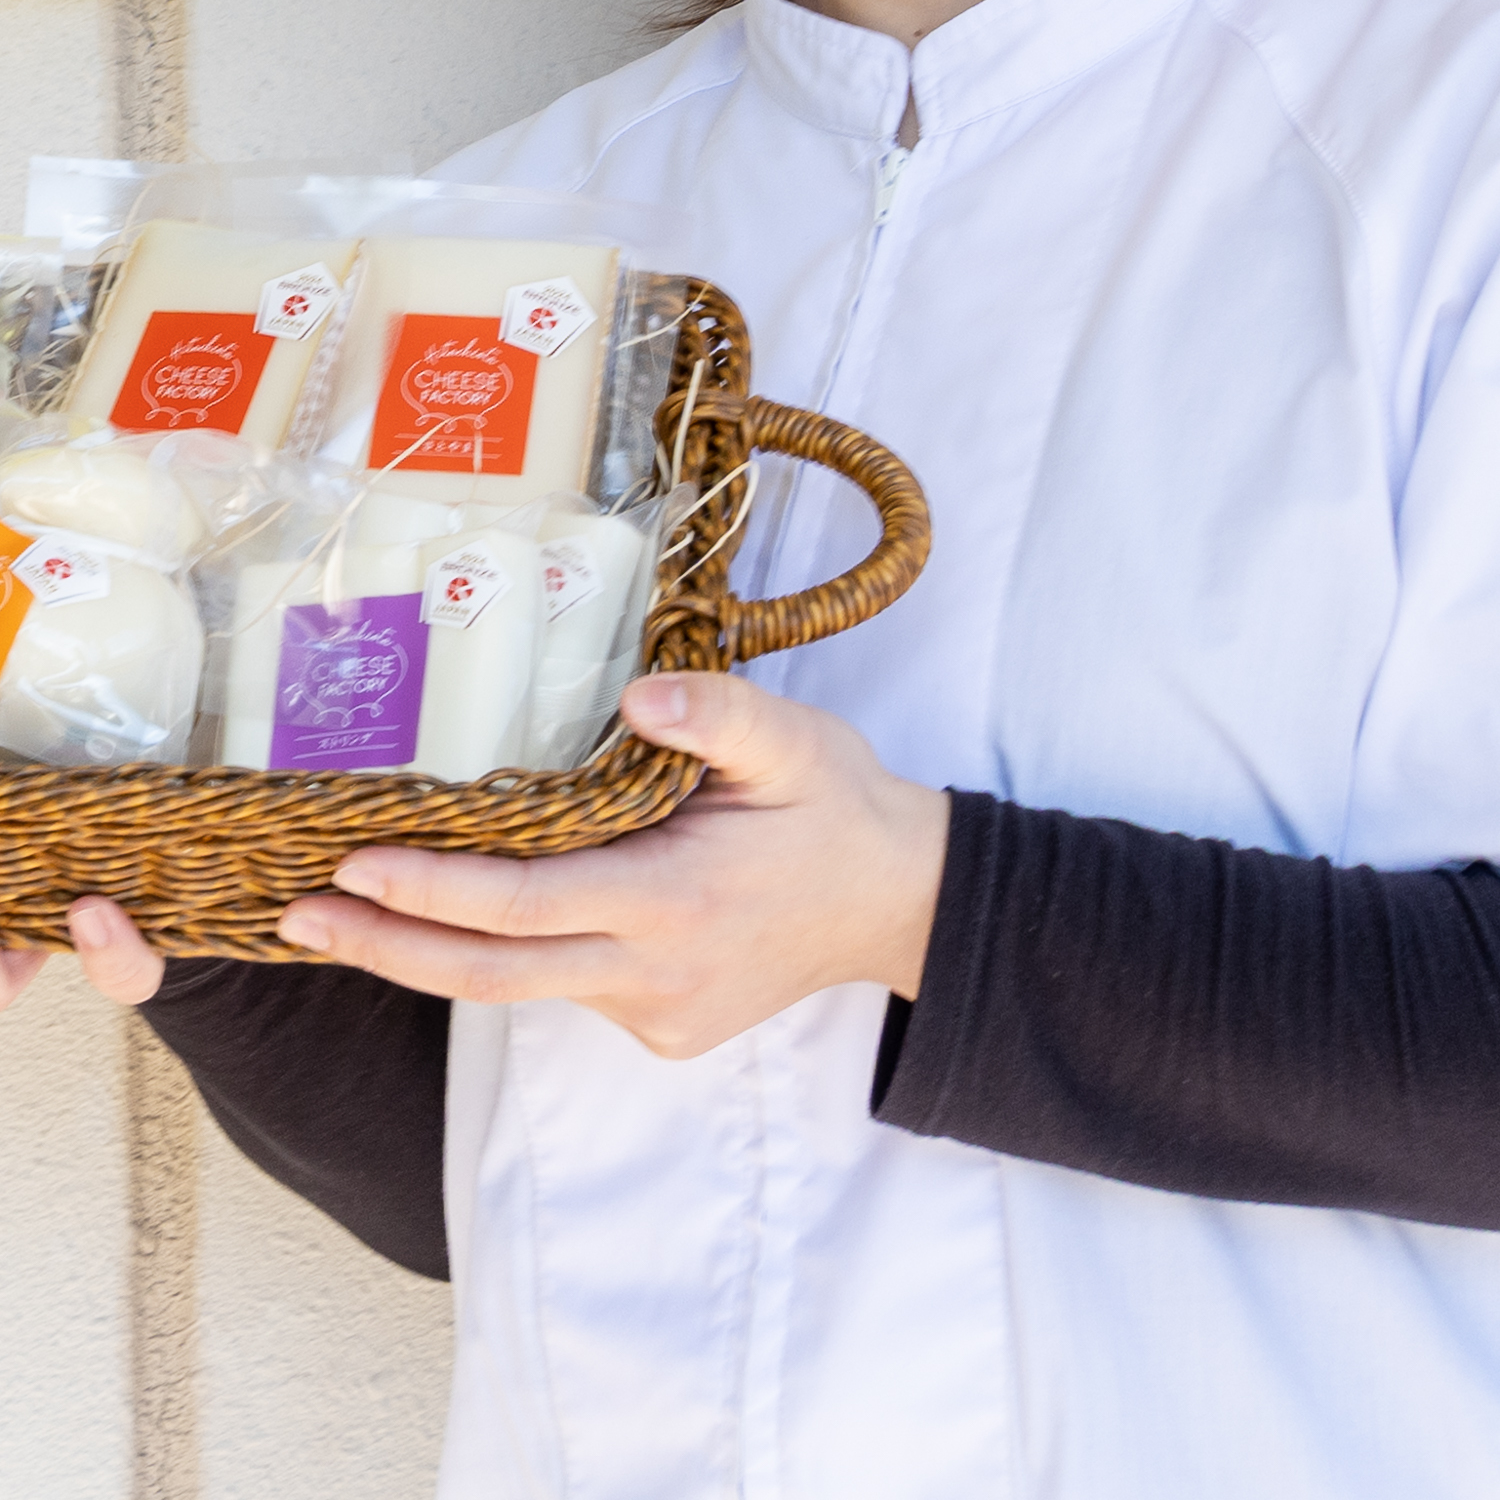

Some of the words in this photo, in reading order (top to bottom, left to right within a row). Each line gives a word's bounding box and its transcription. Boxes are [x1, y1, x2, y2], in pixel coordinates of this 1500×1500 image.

[155, 365, 232, 385] CHEESE
[415, 370, 501, 392] CHEESE
[156, 384, 220, 400] FACTORY
[420, 388, 493, 406] FACTORY
[318, 678, 388, 698] FACTORY
[318, 731, 374, 750] ストリング
